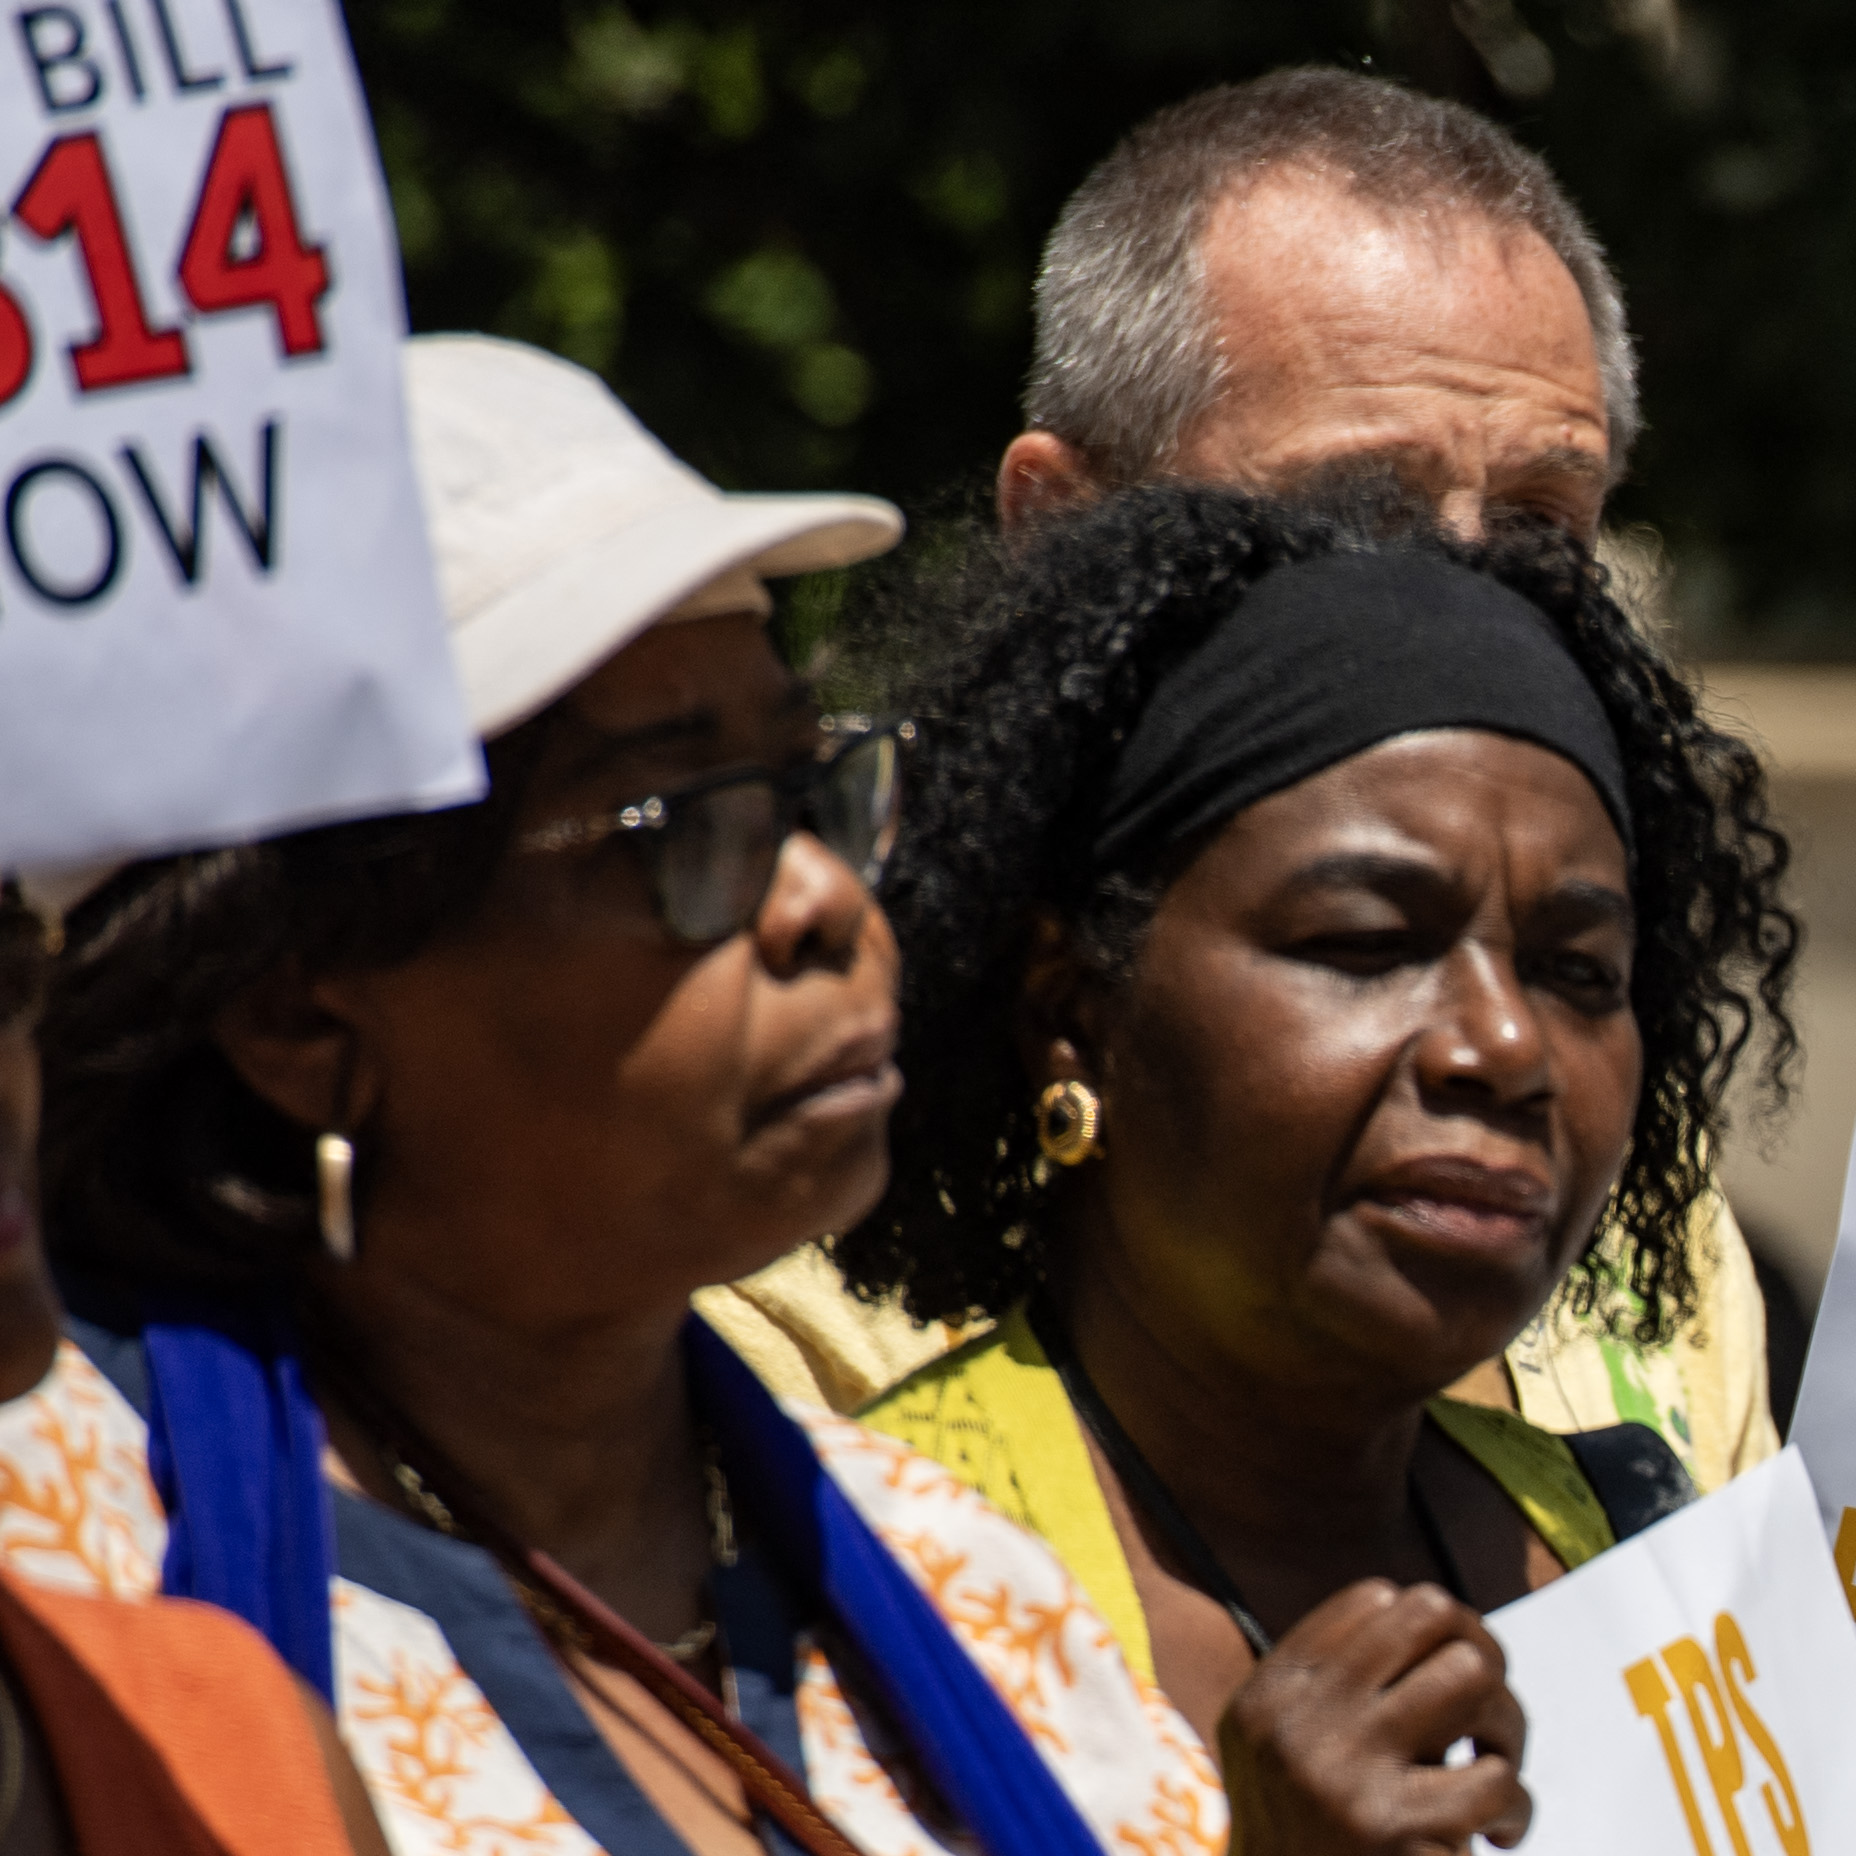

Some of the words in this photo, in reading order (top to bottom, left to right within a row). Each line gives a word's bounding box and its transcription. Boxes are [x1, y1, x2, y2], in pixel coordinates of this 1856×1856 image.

[12, 0, 293, 116] BILL
[0, 101, 330, 416] 14
[1, 415, 281, 608] OW
